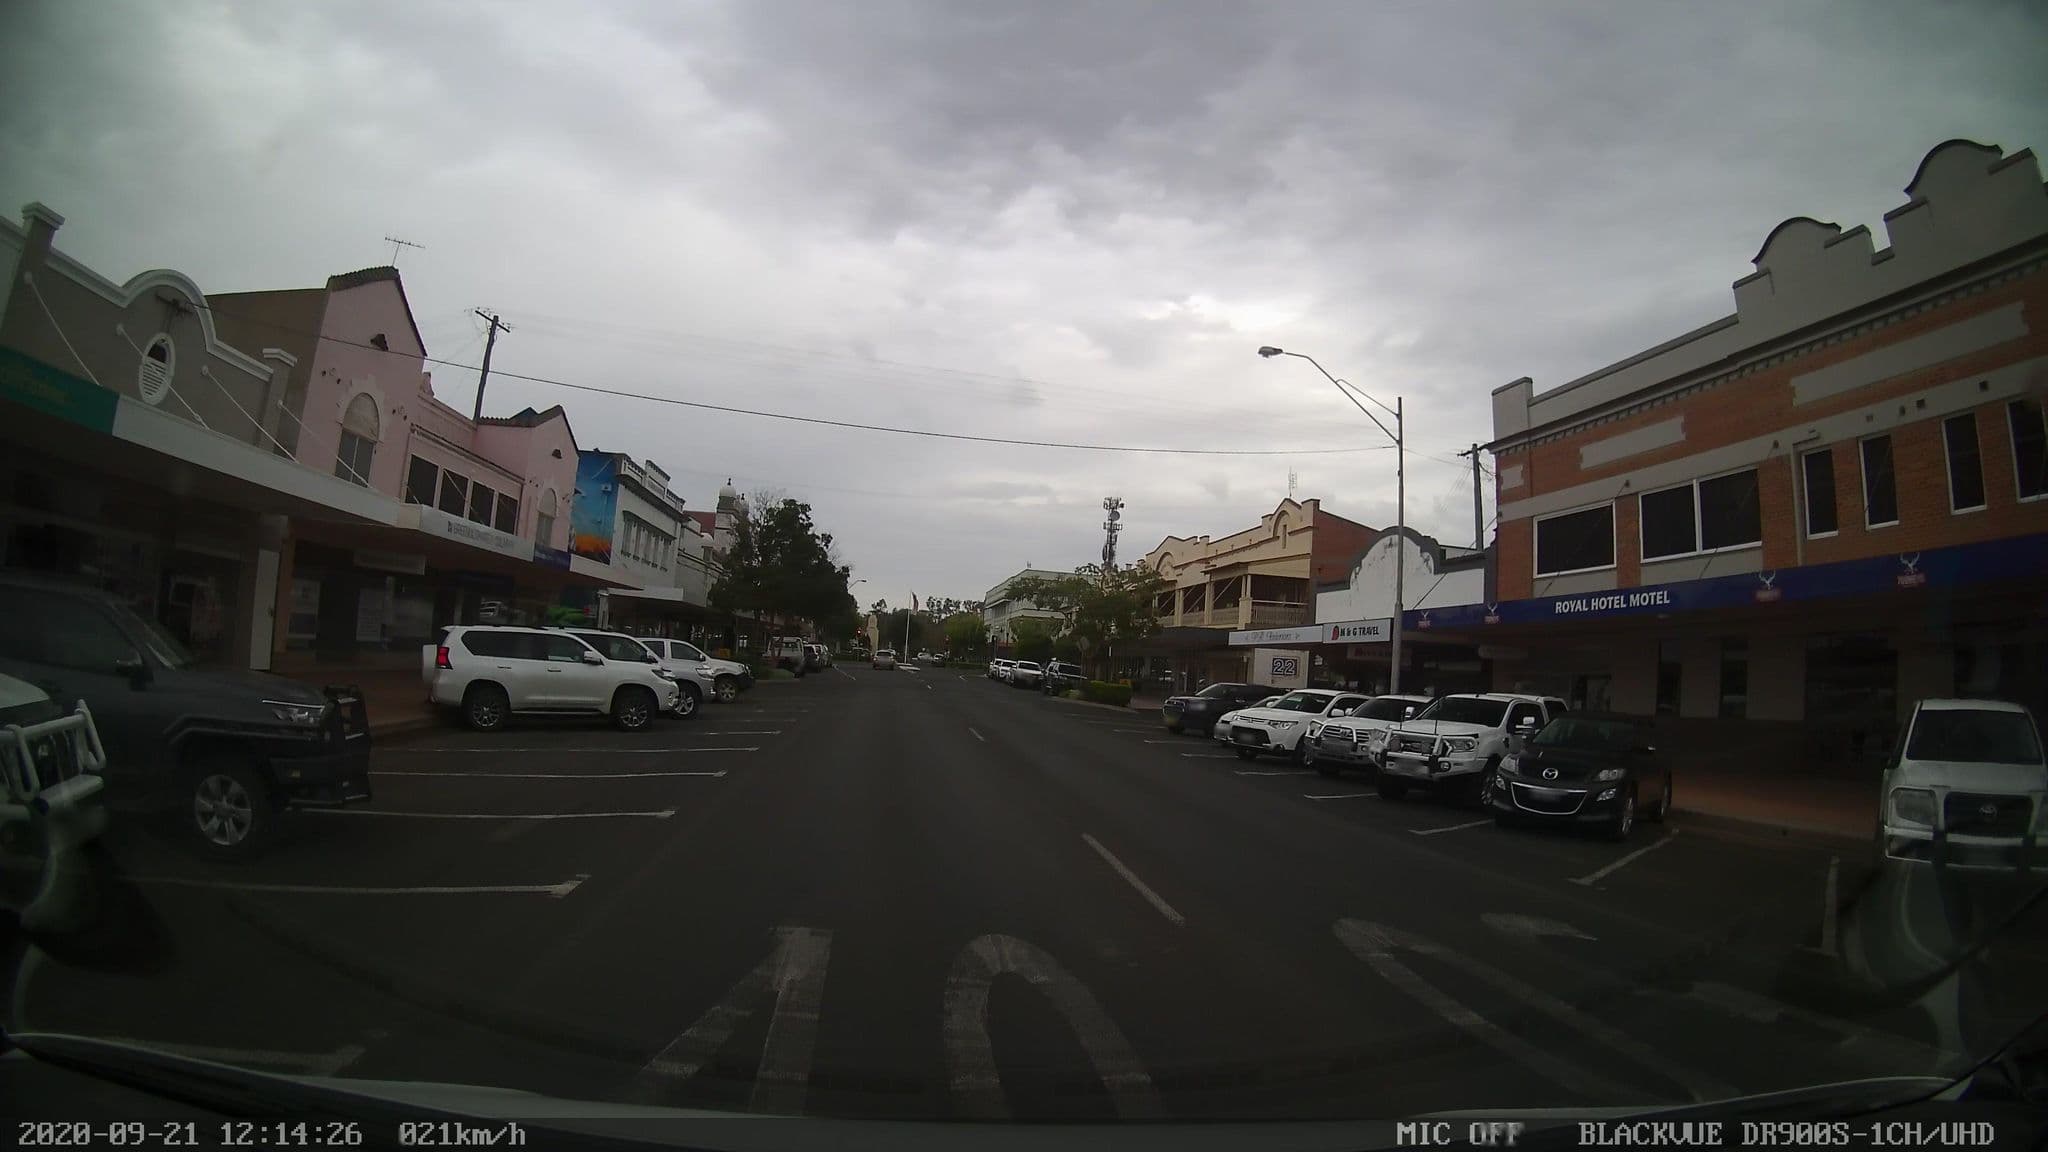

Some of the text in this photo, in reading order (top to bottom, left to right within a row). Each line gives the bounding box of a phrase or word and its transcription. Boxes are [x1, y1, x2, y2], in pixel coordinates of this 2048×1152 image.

[1555, 591, 1671, 614] ROYAL HOTEL MOTEL
[1358, 626, 1380, 636] TRAVEL
[1273, 658, 1295, 675] 22
